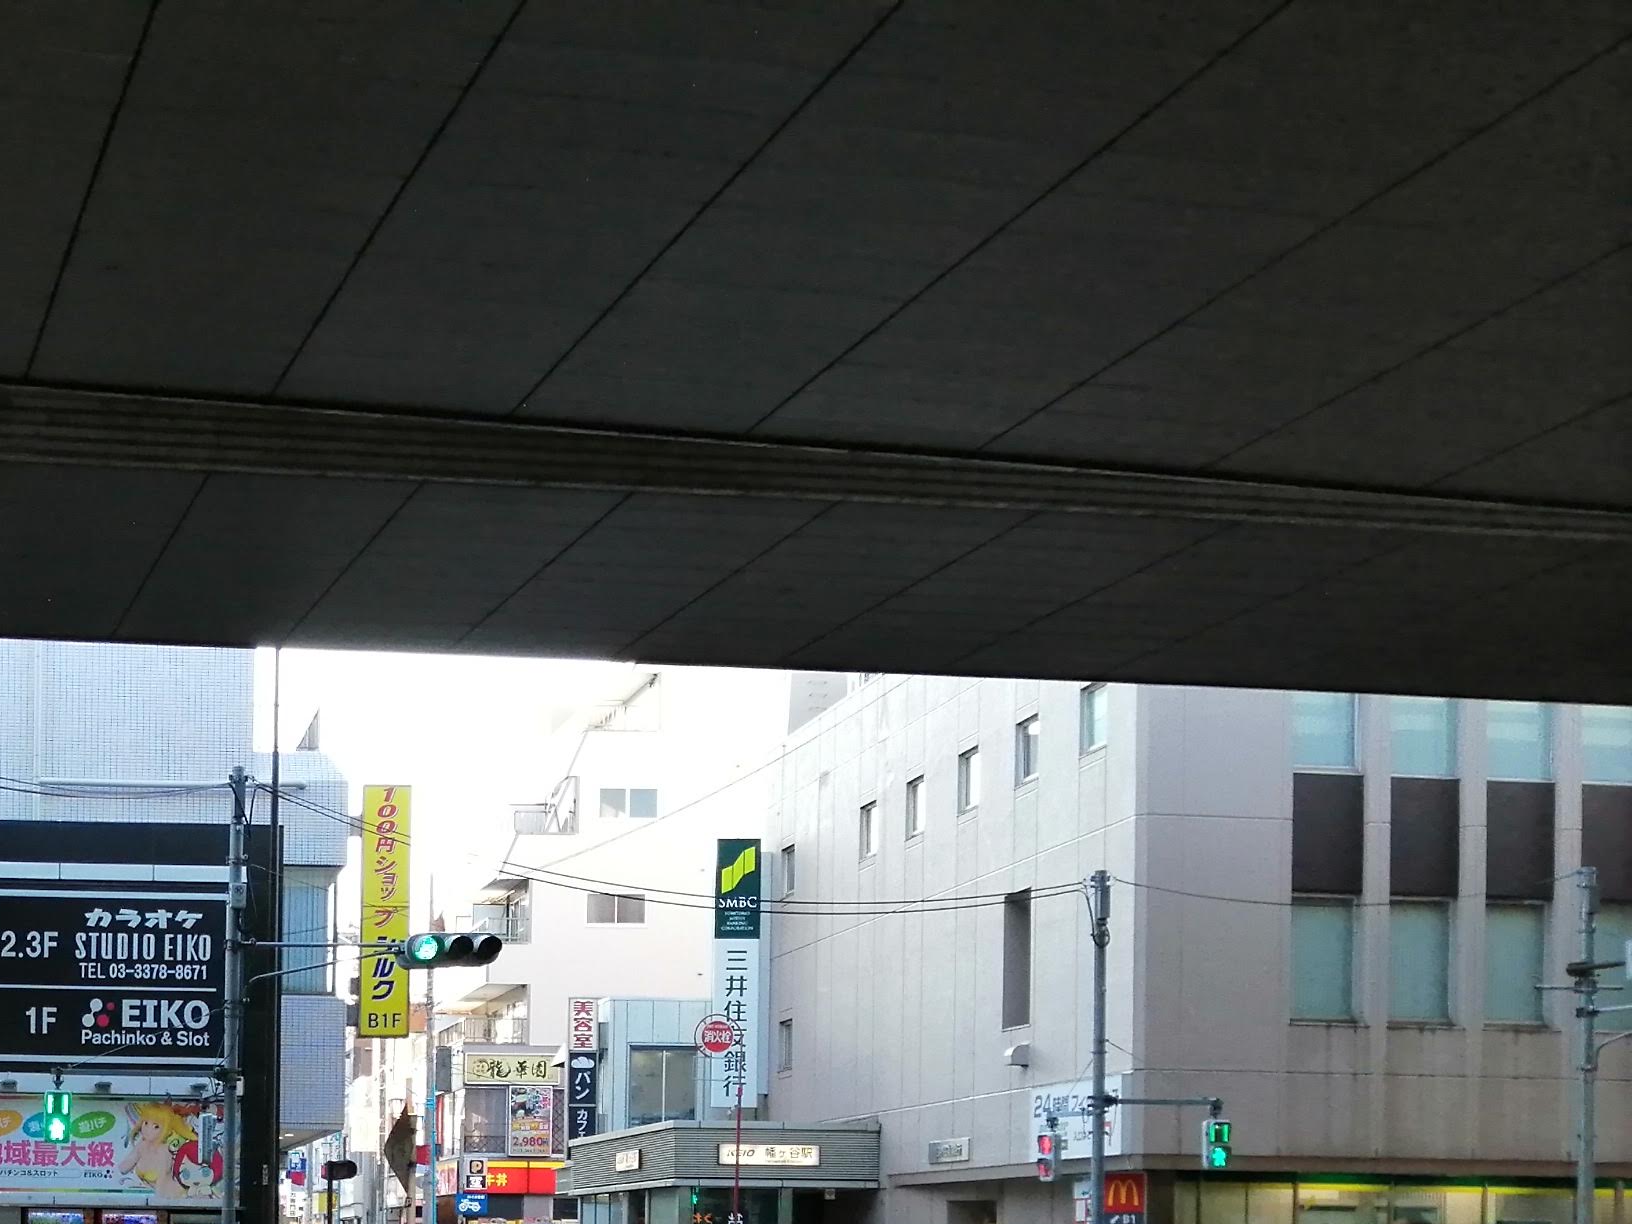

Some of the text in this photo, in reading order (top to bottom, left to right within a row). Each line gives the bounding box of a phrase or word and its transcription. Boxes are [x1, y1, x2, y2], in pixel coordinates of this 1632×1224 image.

[374, 786, 398, 928] 100円ショップ
[718, 896, 757, 908] SMBC
[84, 908, 203, 928] カラオケ
[1, 931, 212, 962] 2.3F STUDIO EIKO
[79, 962, 208, 980] TEL 03-3378-8671
[25, 999, 210, 1035] 1F EIKO
[368, 1013, 402, 1028] B1F
[573, 1000, 593, 1049] 美容室
[81, 1030, 210, 1047] Pachinko & Slot
[704, 1030, 732, 1043] 消火栓
[574, 1070, 592, 1100] パン
